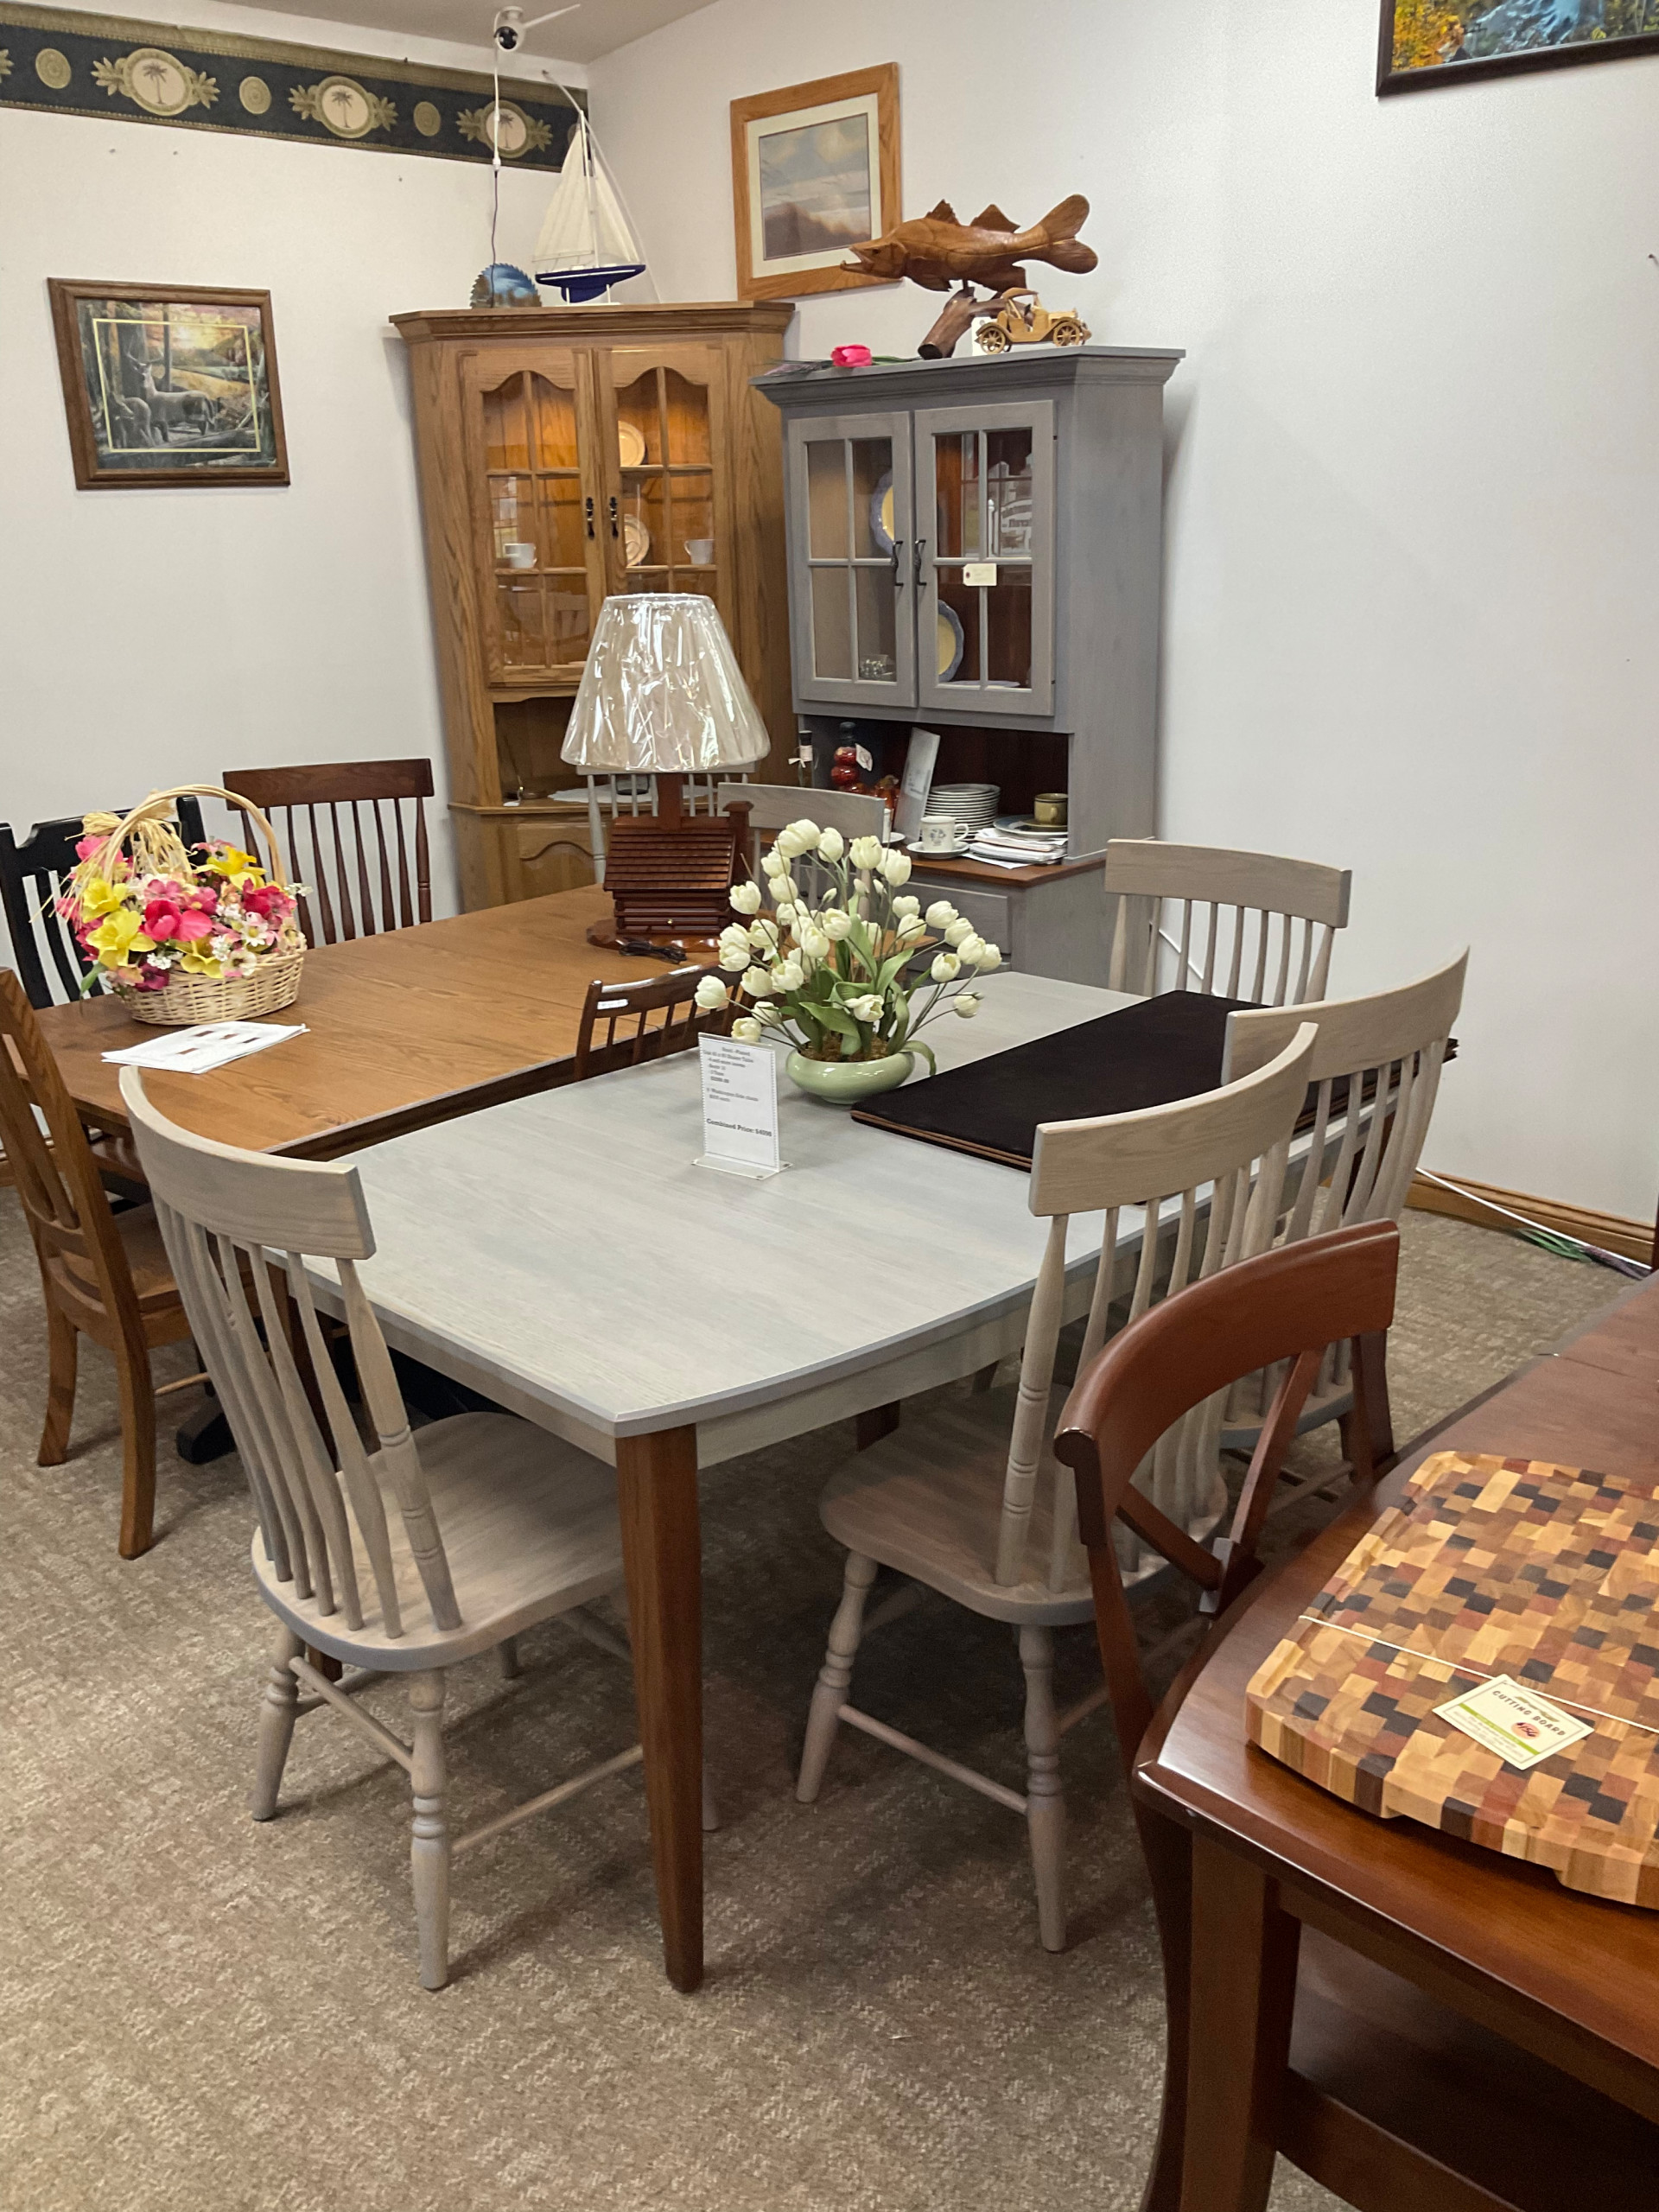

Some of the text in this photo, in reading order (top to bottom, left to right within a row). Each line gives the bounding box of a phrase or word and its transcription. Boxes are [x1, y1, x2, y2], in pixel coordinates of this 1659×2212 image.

[706, 1117, 736, 1130] Combined
[1492, 1690, 1532, 1715] CUTTING
[1533, 1715, 1566, 1736] BOARD
